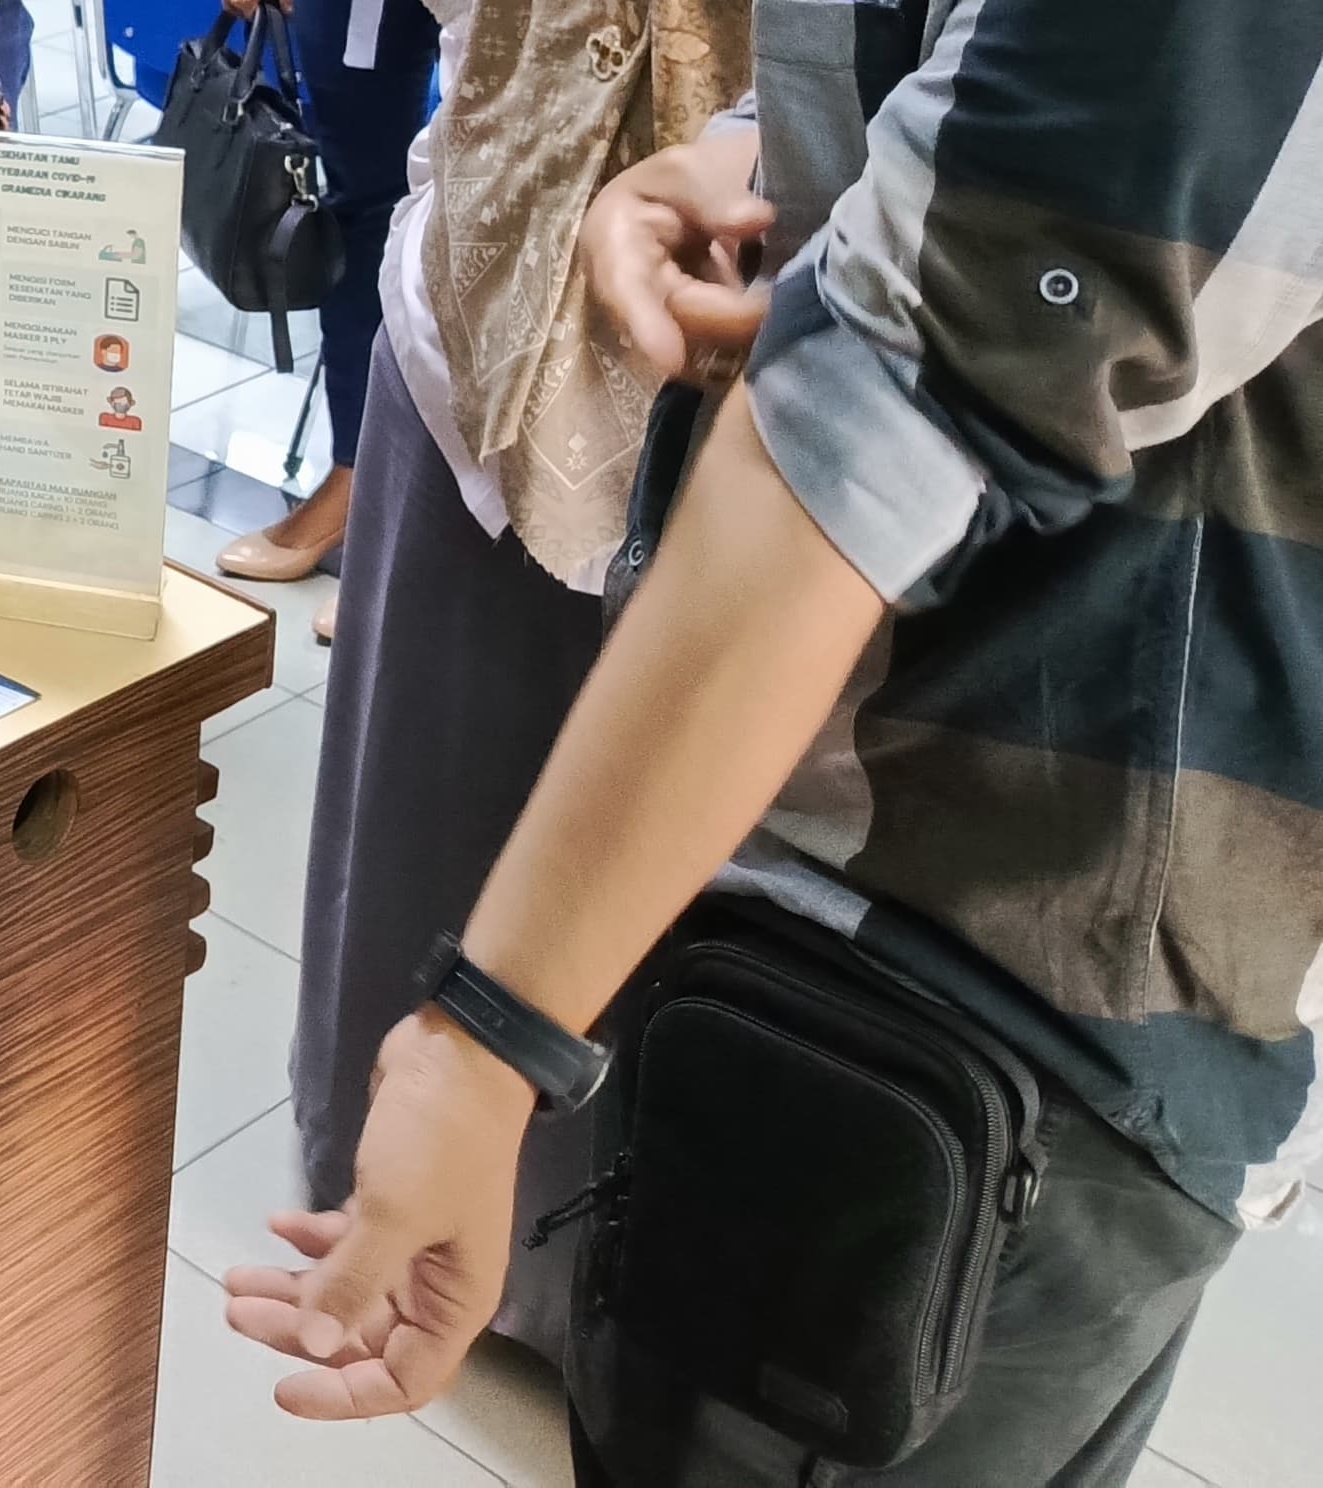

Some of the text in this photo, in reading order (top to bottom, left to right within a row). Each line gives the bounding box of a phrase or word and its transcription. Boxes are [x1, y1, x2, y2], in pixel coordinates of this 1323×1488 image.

[50, 155, 80, 165] TAMU
[1, 183, 52, 197] GRAMEDIA
[55, 189, 106, 202] CIKARANG
